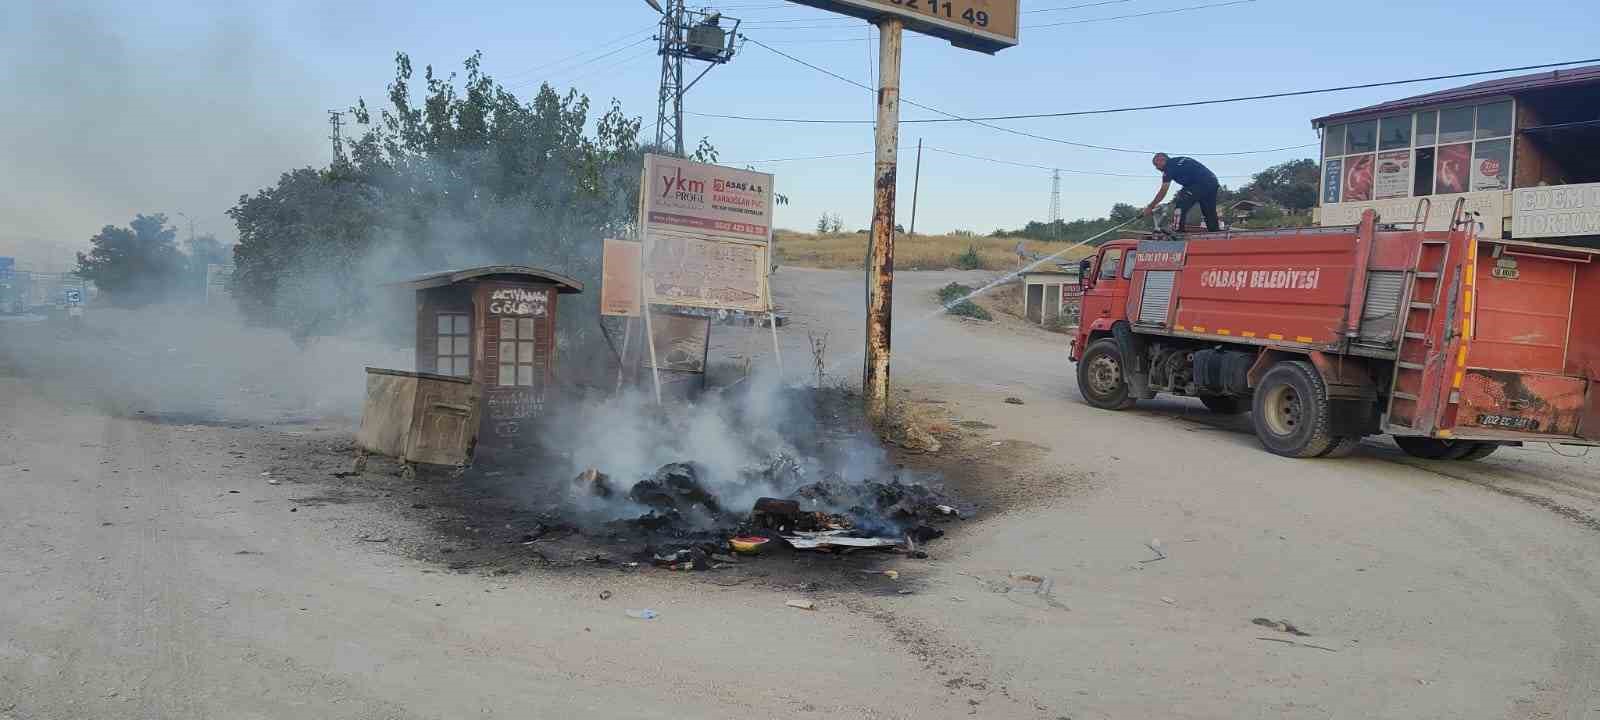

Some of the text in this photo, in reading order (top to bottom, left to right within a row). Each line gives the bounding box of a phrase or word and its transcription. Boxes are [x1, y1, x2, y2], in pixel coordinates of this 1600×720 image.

[961, 7, 989, 27] 49
[663, 167, 705, 198] ykm
[1200, 266, 1320, 291] GÖLBAŞI BELEDİYESİ
